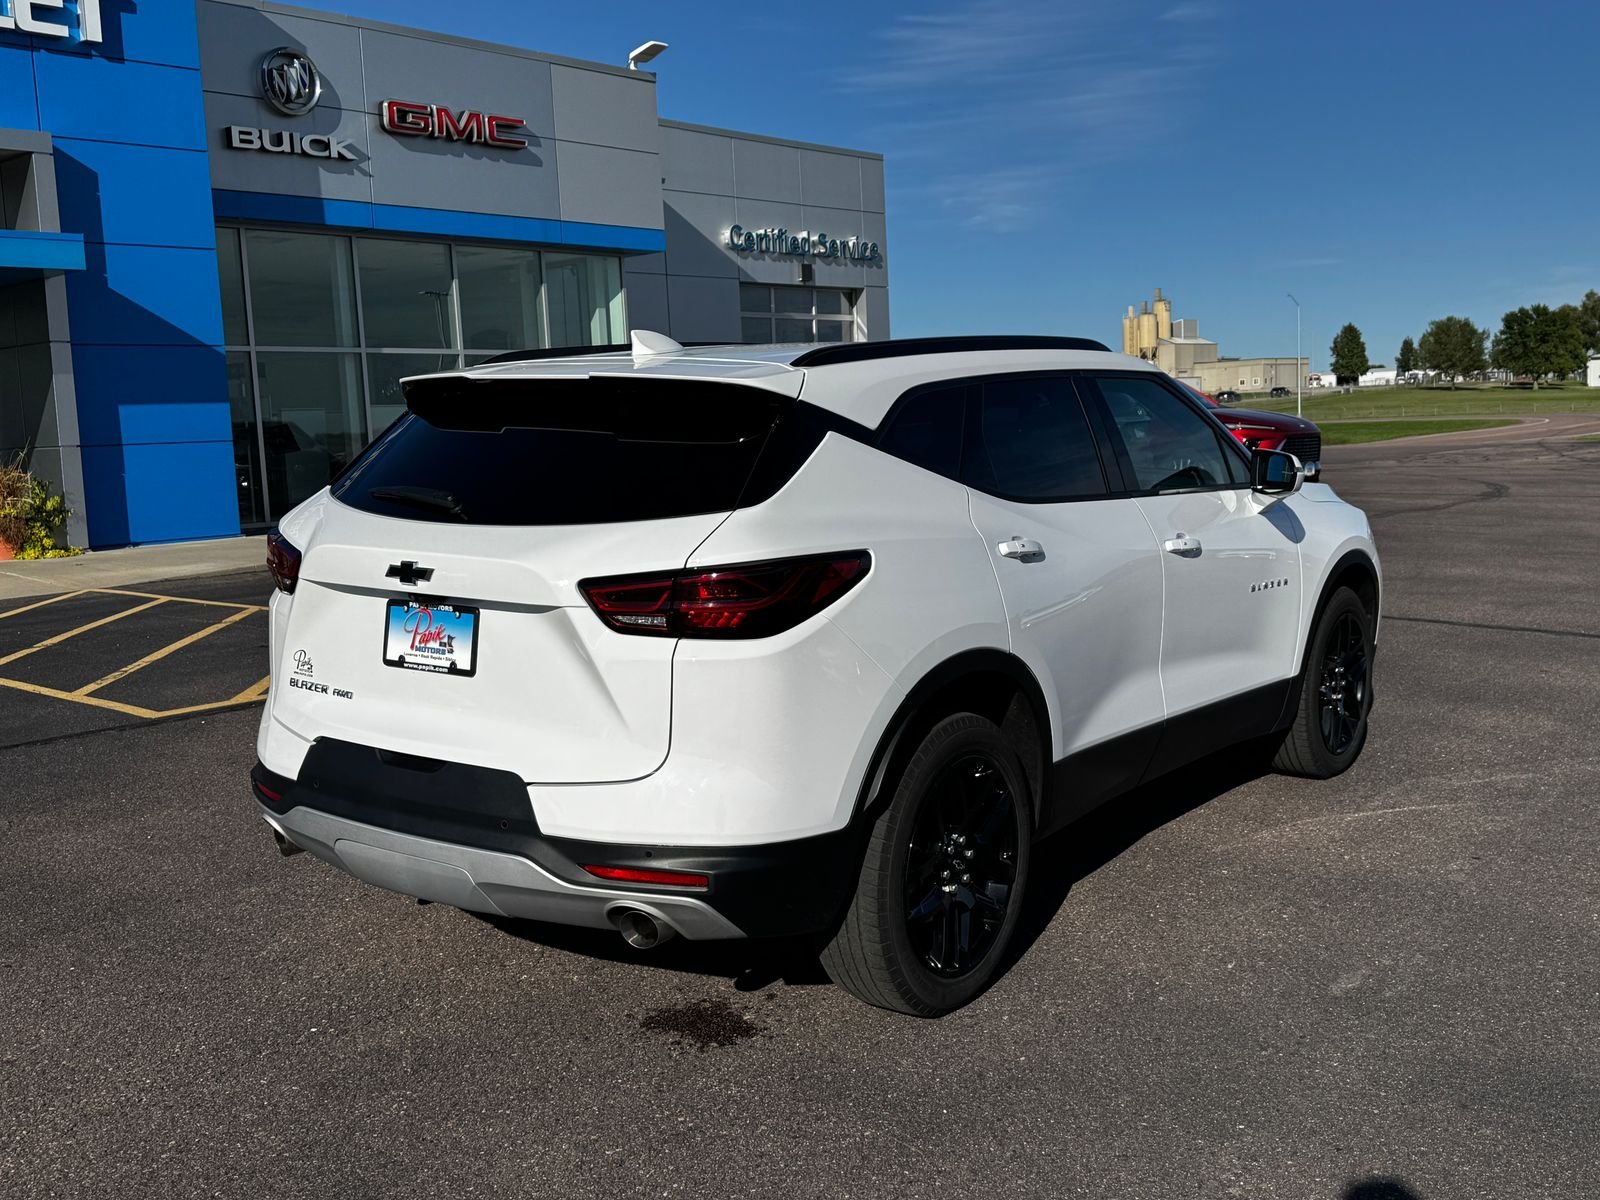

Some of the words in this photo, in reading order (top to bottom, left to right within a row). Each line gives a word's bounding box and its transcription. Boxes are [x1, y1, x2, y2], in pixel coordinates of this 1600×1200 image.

[379, 98, 529, 149] GMC
[227, 125, 358, 161] BUICK
[727, 224, 811, 256] Certified
[817, 232, 879, 259] Service
[403, 608, 447, 651] Papik
[403, 662, 449, 673] www.papik.com
[415, 645, 447, 656] MOTORS
[289, 677, 329, 695] BLAZER
[332, 688, 354, 700] AWD
